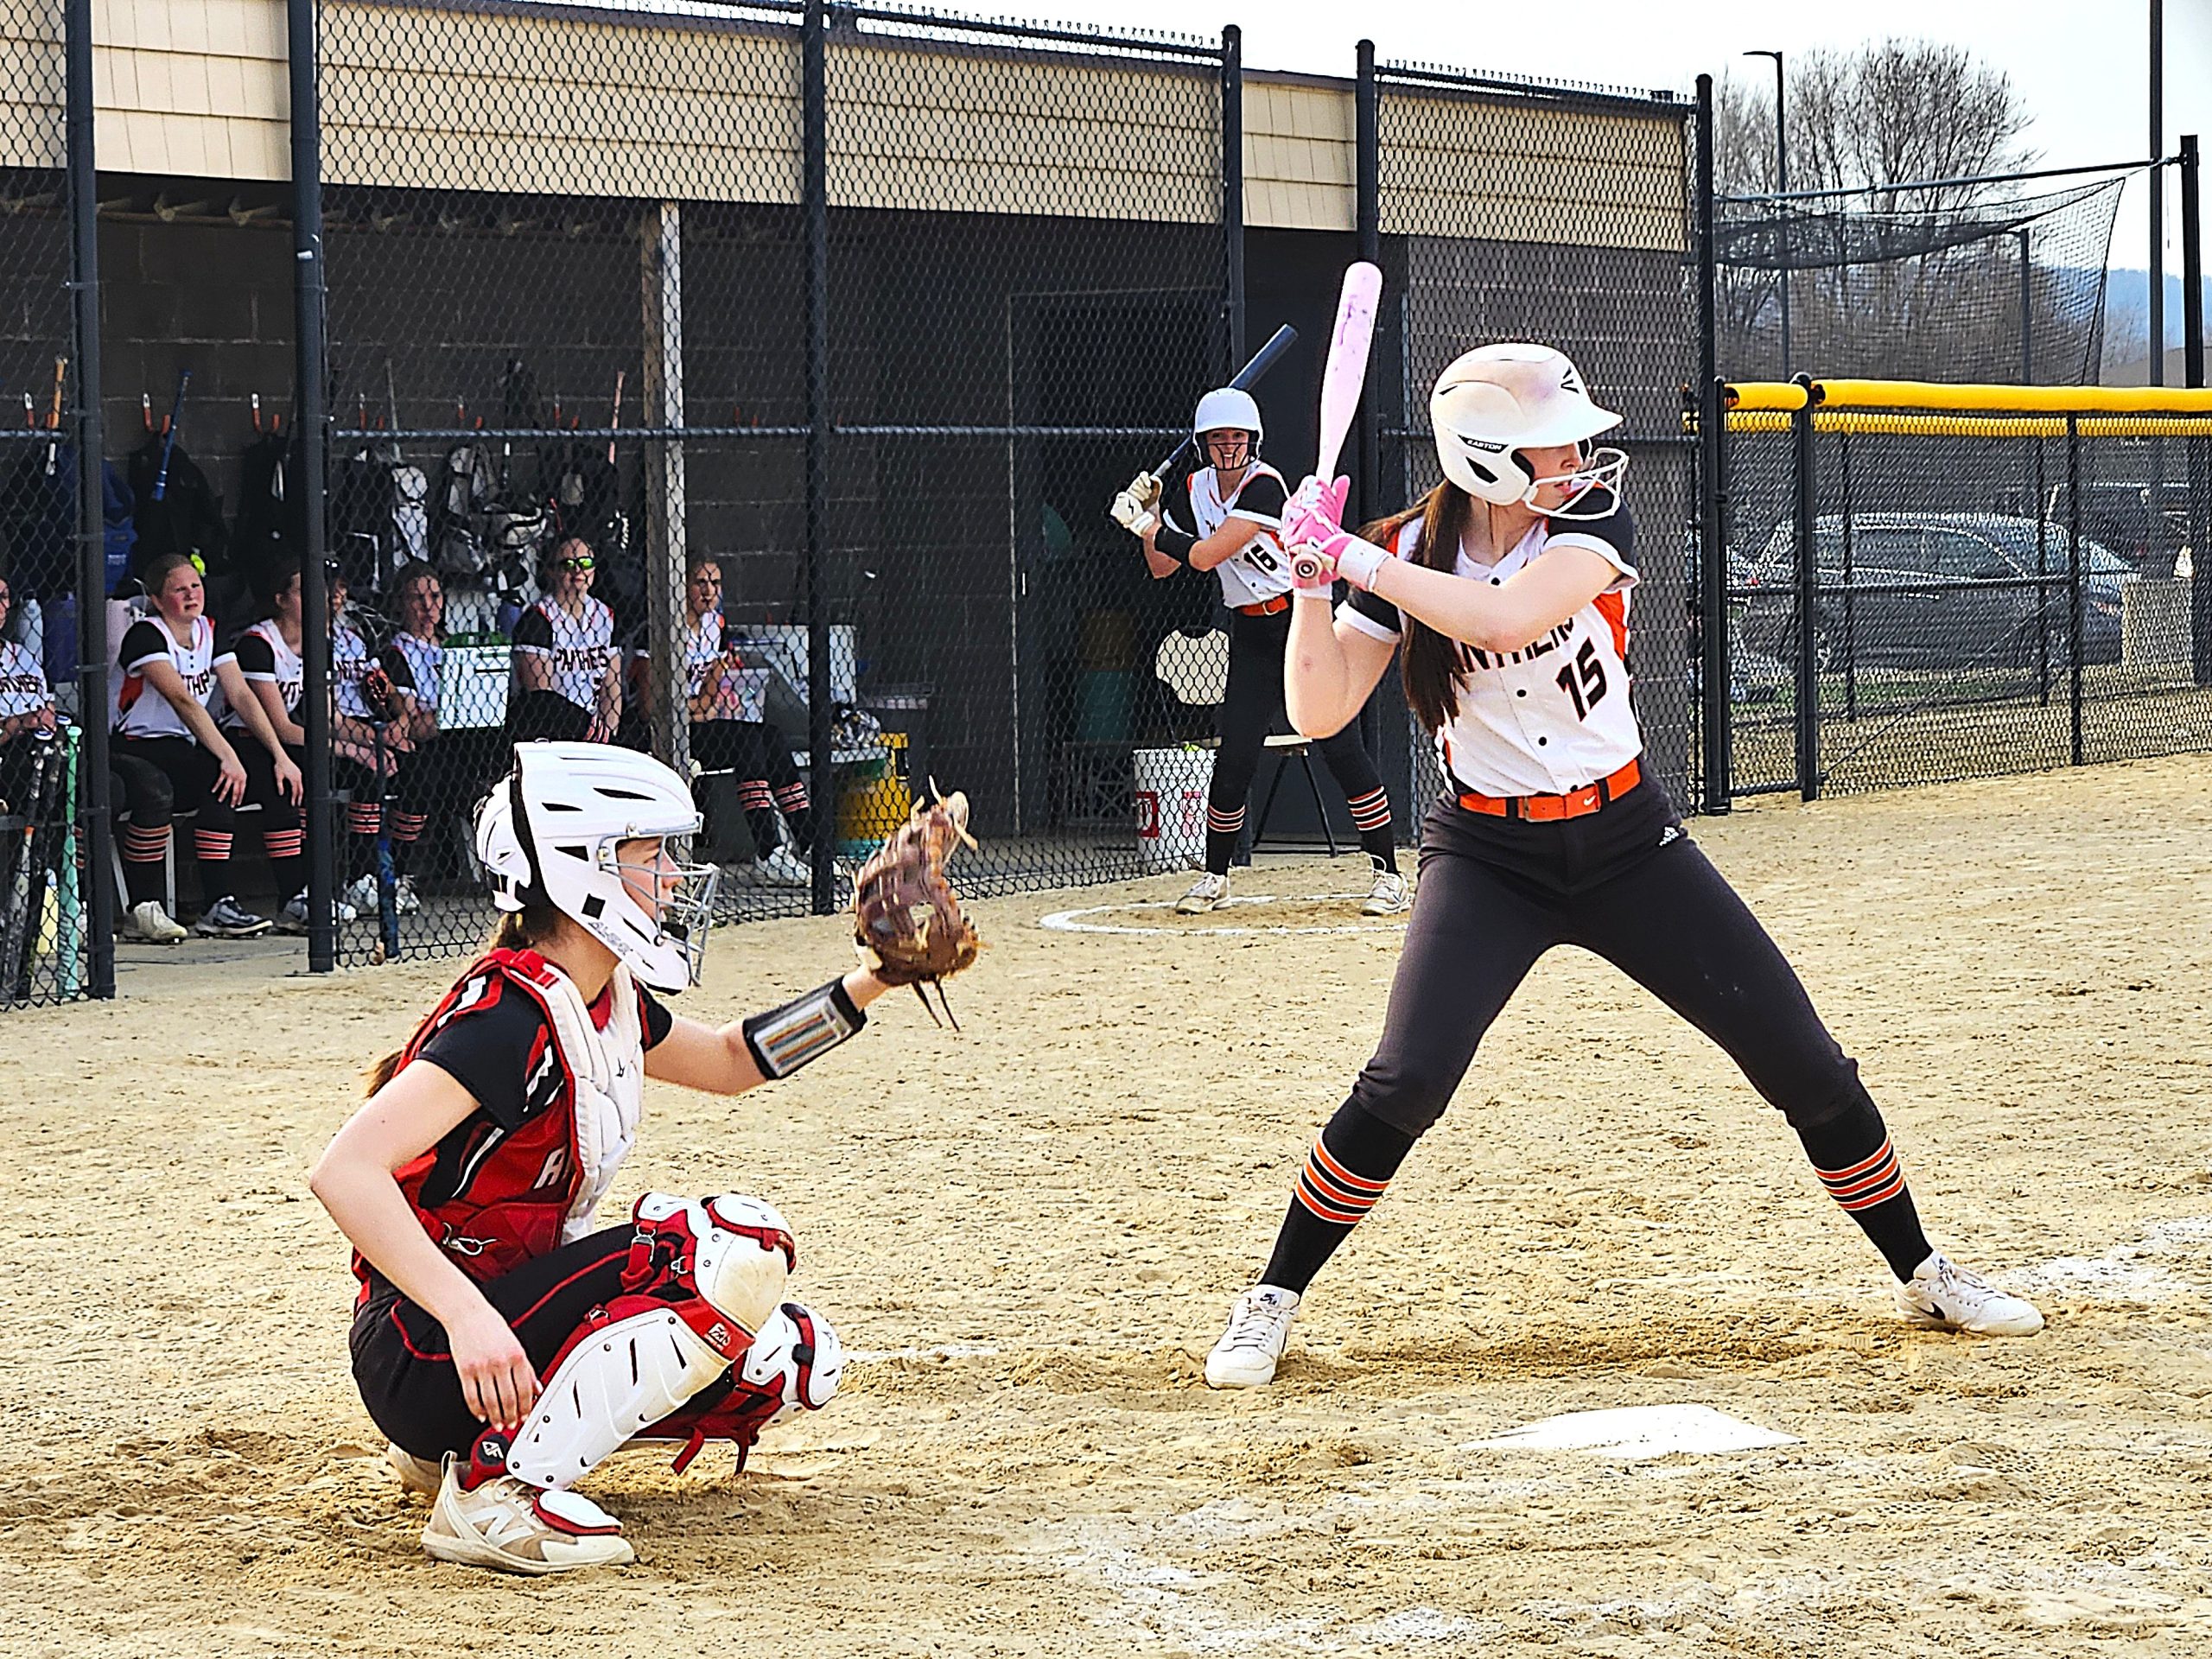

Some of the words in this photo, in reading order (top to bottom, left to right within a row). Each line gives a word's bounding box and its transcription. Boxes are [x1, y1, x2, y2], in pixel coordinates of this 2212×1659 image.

[1466, 439, 1502, 450] EASTON
[1243, 543, 1278, 577] 16
[1555, 636, 1607, 722] 15
